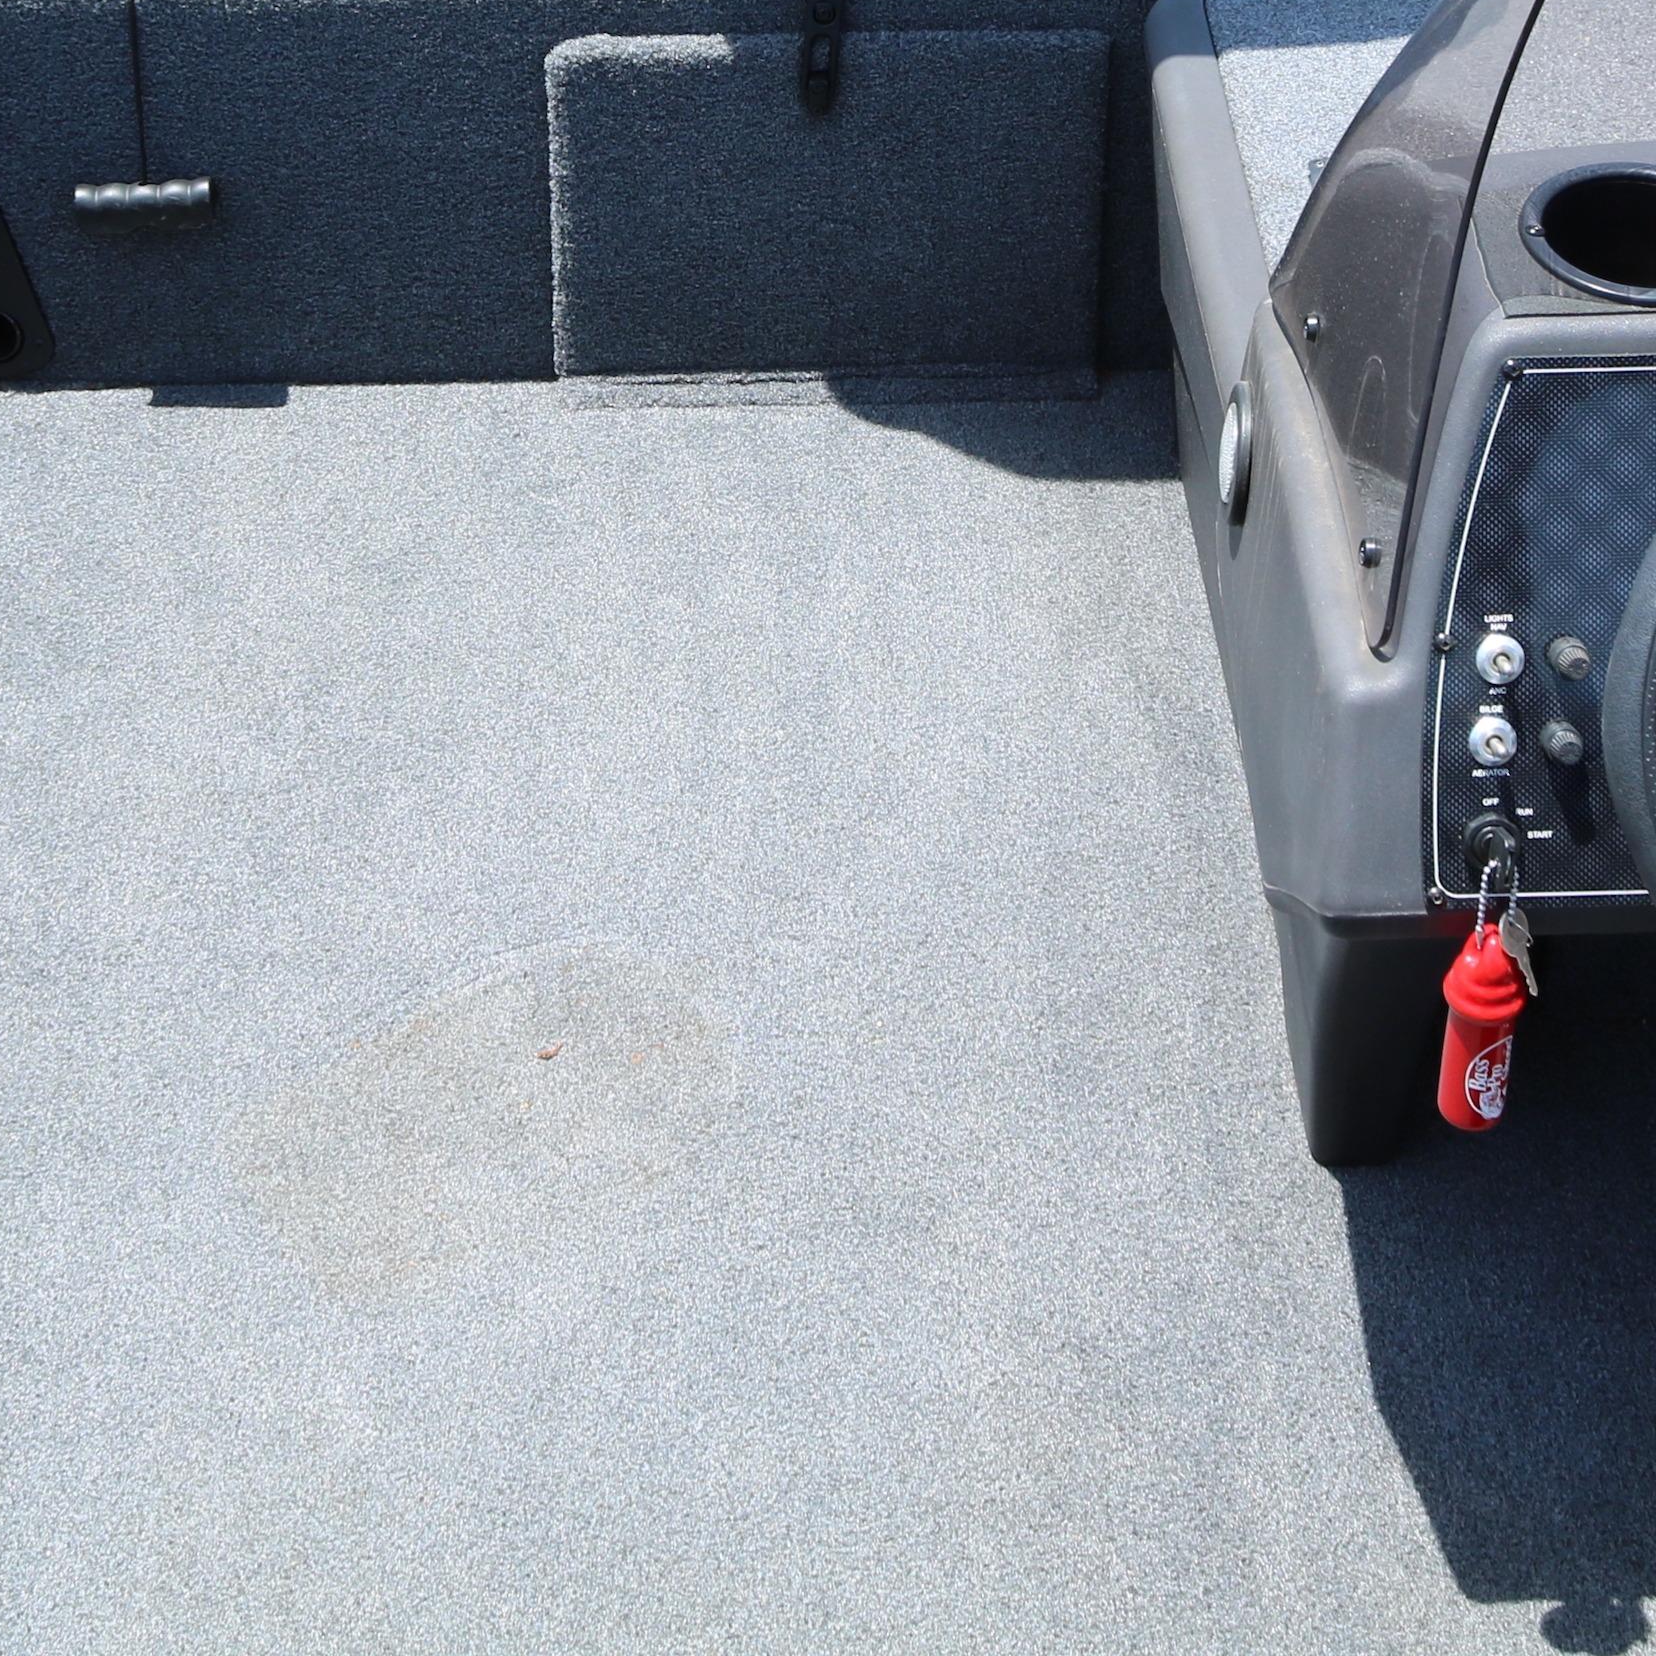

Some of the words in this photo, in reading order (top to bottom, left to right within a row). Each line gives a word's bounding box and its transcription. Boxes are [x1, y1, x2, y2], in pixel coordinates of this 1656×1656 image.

[1484, 614, 1514, 623] LIGHTS
[1490, 623, 1507, 631] NAV
[1489, 687, 1506, 696] ANC
[1479, 705, 1504, 713] BILGE
[1471, 769, 1511, 777] AERATOR
[1482, 798, 1499, 806] OFF
[1515, 807, 1534, 816] RUN
[1527, 830, 1553, 839] START
[1469, 1059, 1489, 1092] Bass
